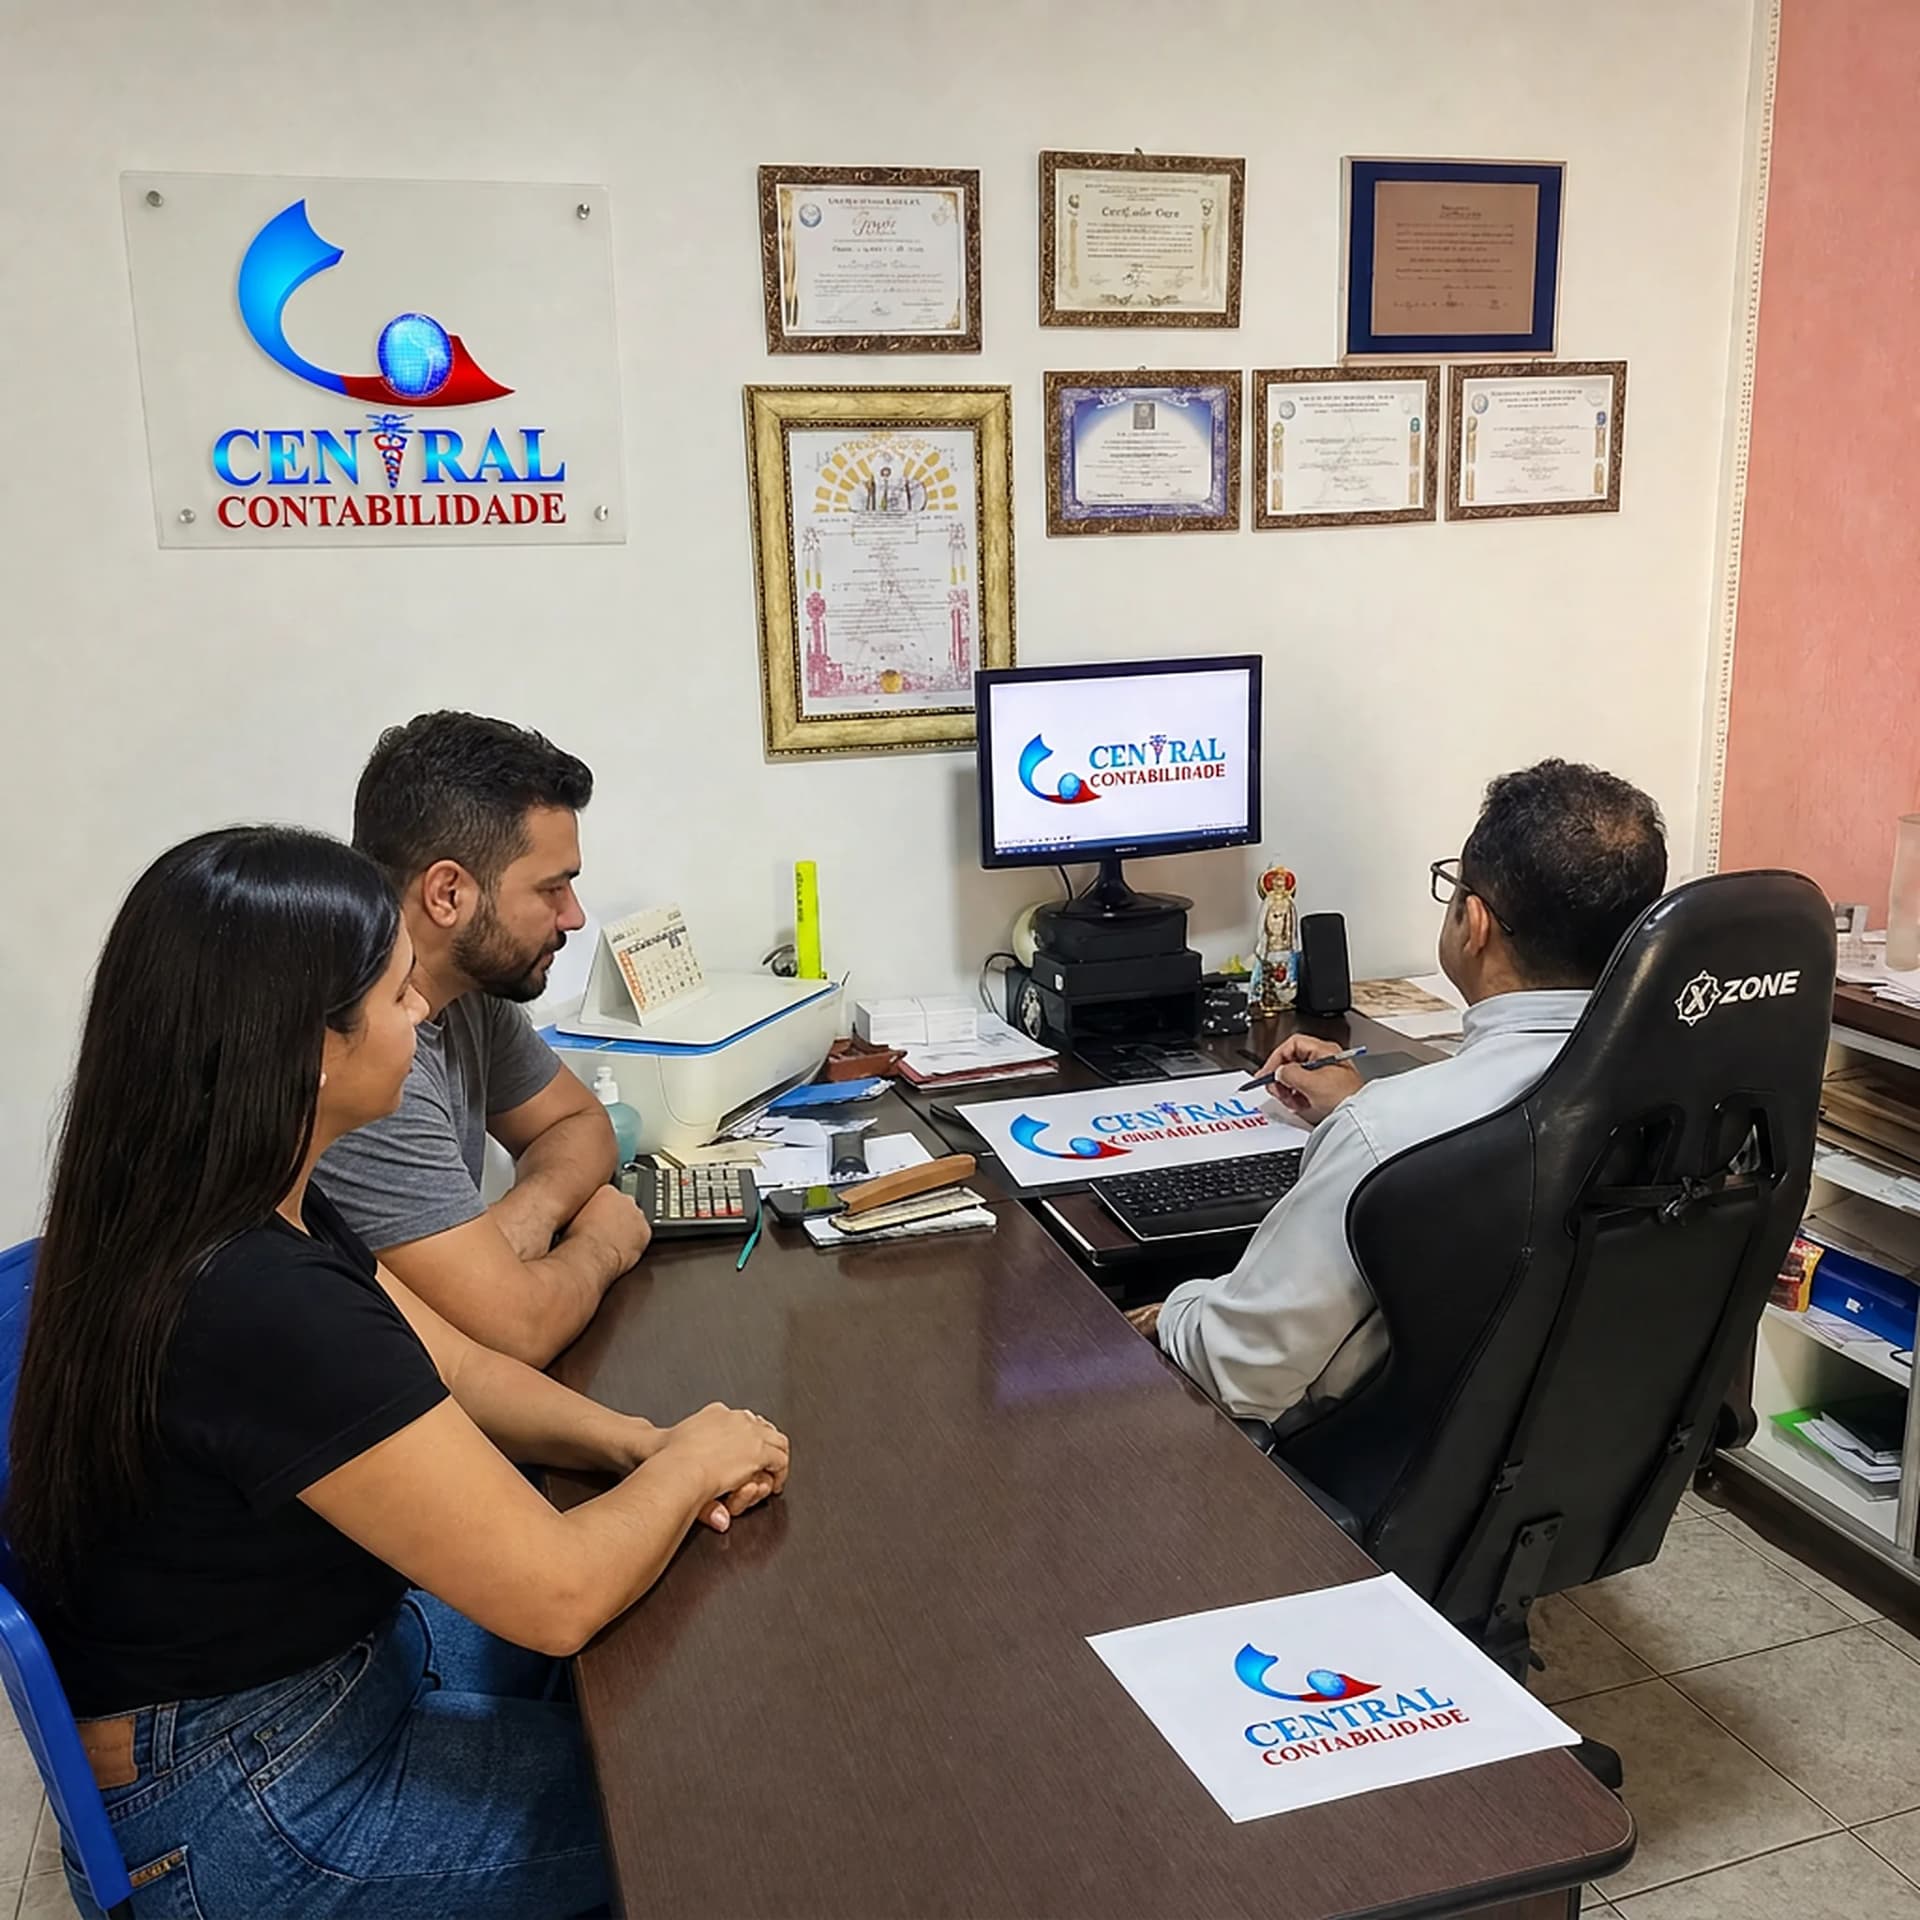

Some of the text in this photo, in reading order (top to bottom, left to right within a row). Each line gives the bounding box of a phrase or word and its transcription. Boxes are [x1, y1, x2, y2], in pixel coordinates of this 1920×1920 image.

[212, 414, 566, 488] CENTRAL
[217, 493, 567, 528] CONTABILIDADE
[1089, 735, 1226, 770] CENTRAL
[1719, 970, 1801, 1004] ZONE
[1244, 1687, 1454, 1747] CENTRAL
[1262, 1709, 1470, 1766] CONTABILIDADE
